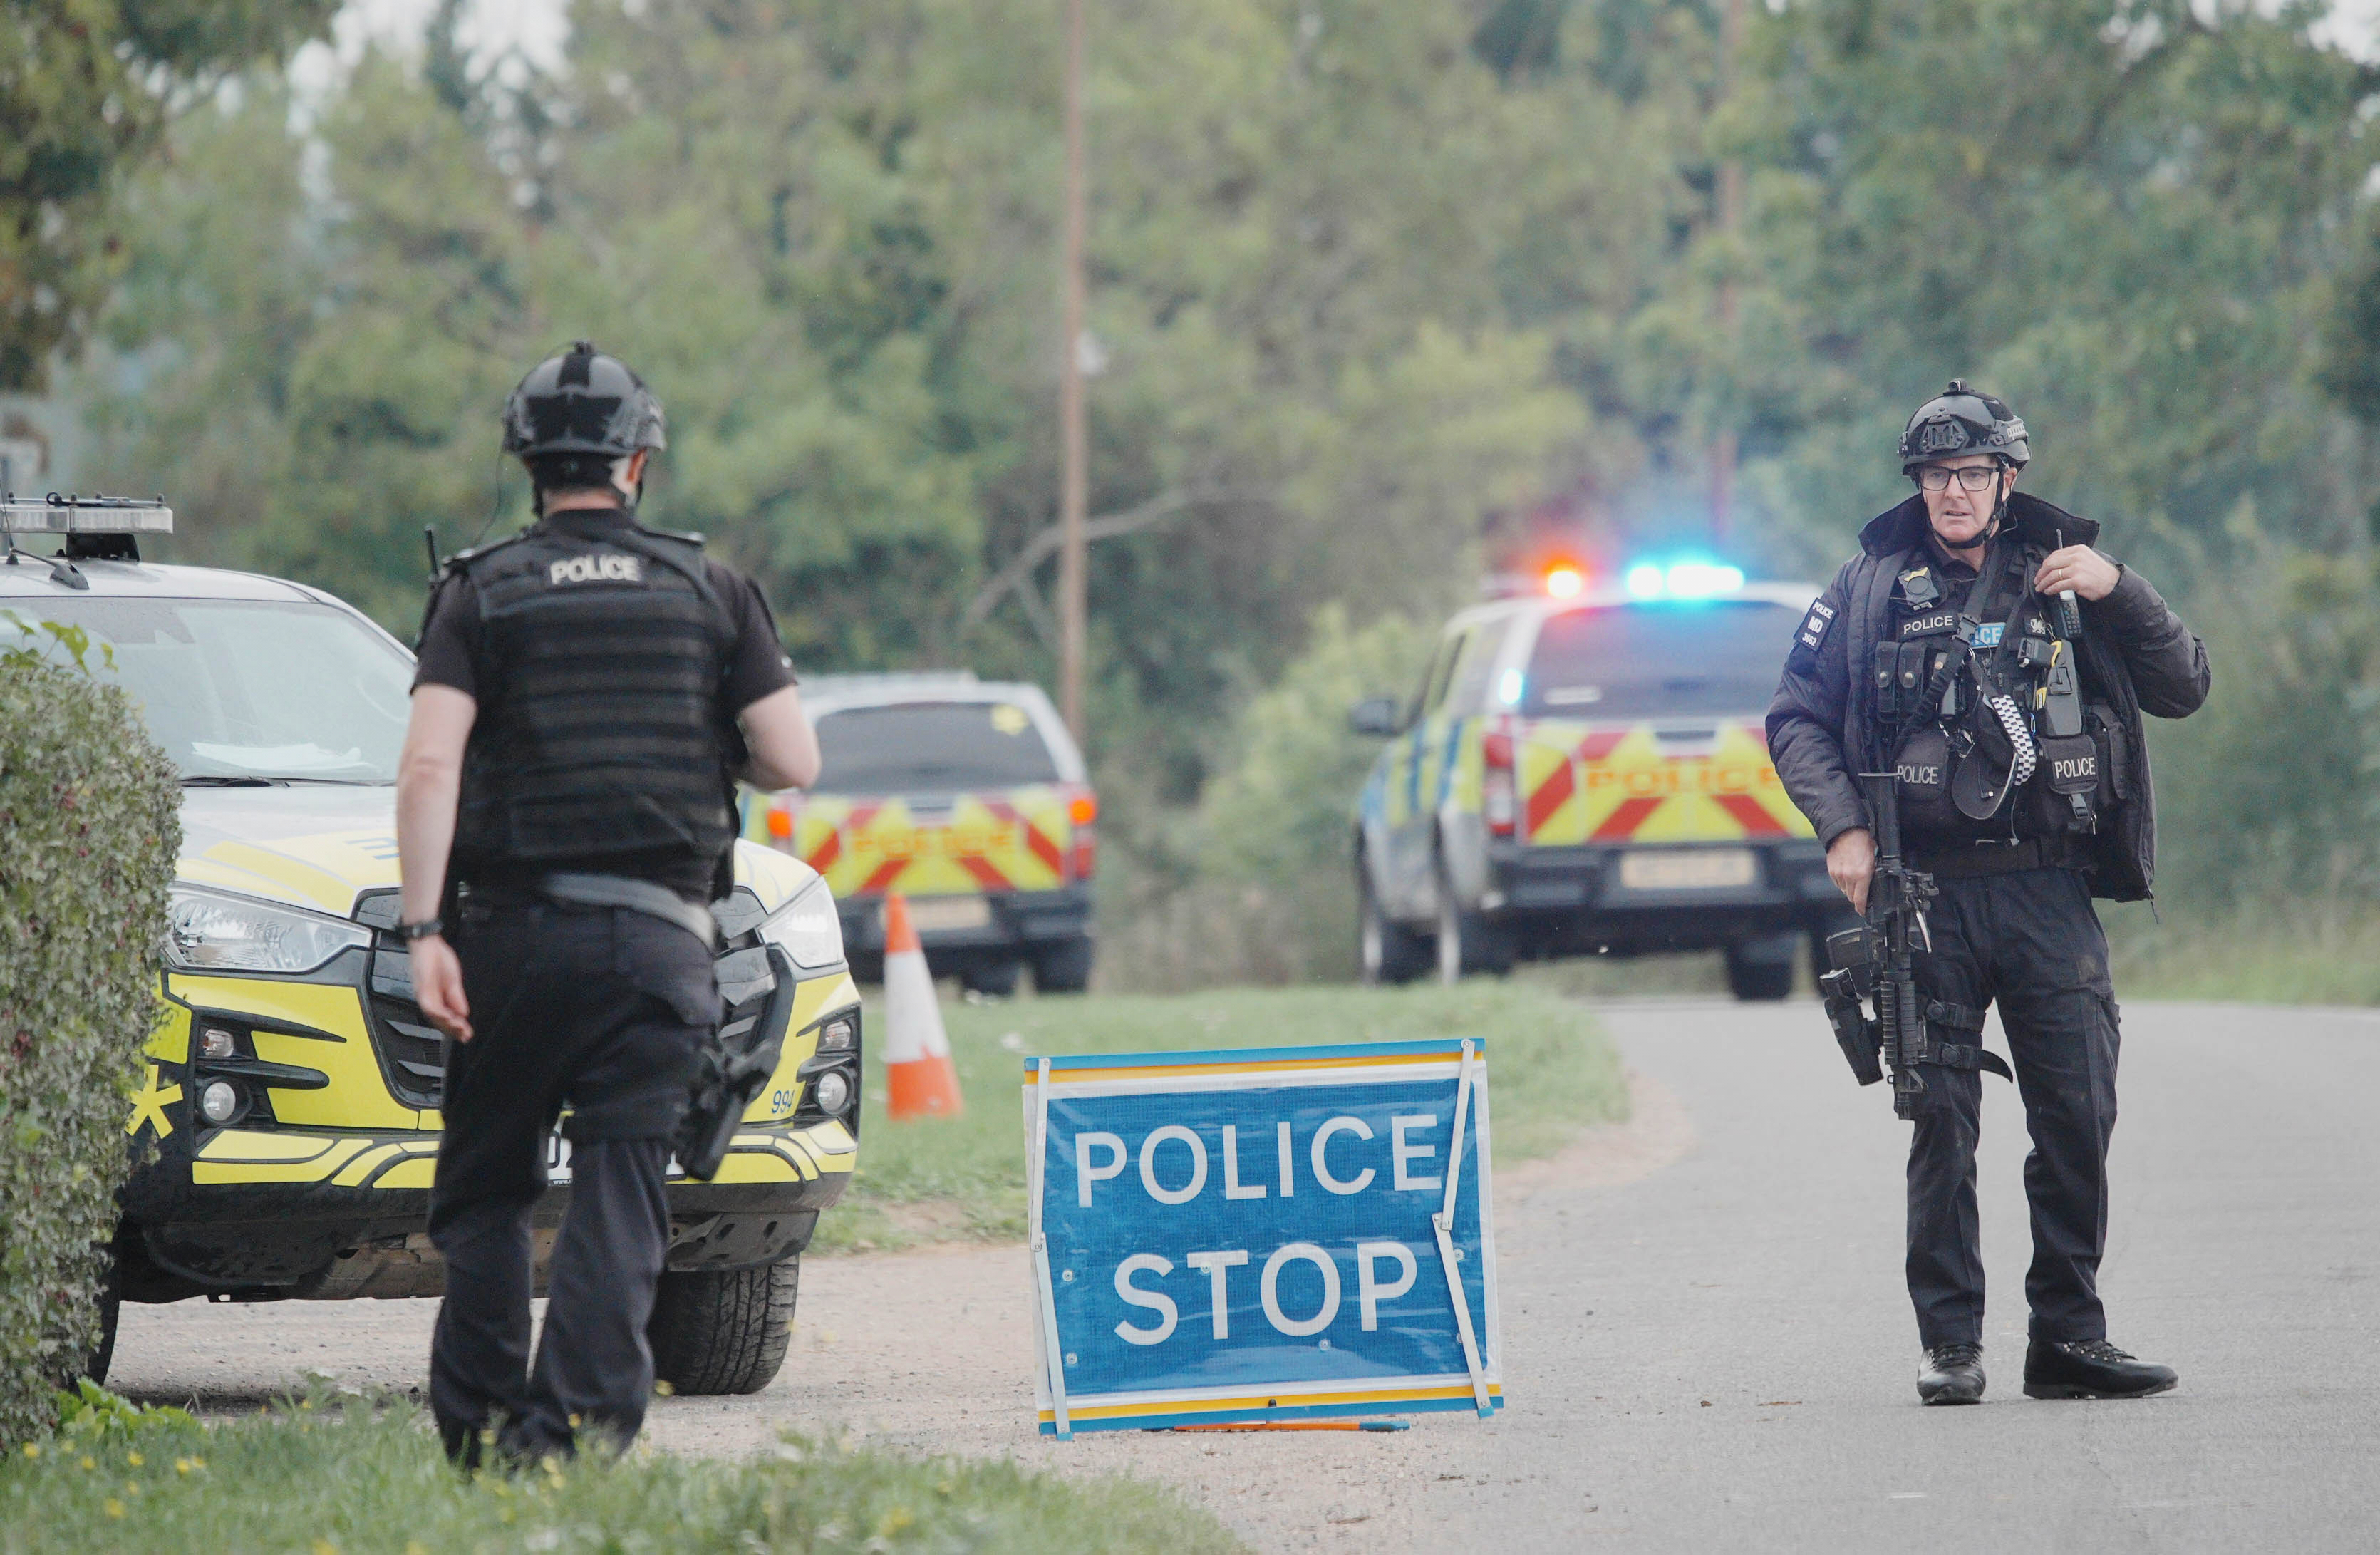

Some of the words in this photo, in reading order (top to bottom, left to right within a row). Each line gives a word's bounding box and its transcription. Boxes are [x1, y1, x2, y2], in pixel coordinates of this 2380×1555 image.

[550, 554, 640, 584] POLICE
[1812, 601, 1834, 619] POLICE
[1807, 616, 1823, 634] MD
[1903, 615, 1953, 635] POLICE
[1585, 761, 1781, 795] POLICE
[1897, 765, 1939, 784] POLICE
[2054, 757, 2096, 779] POLICE
[1075, 1114, 1442, 1208] POLICE
[1114, 1242, 1418, 1346] STOP
